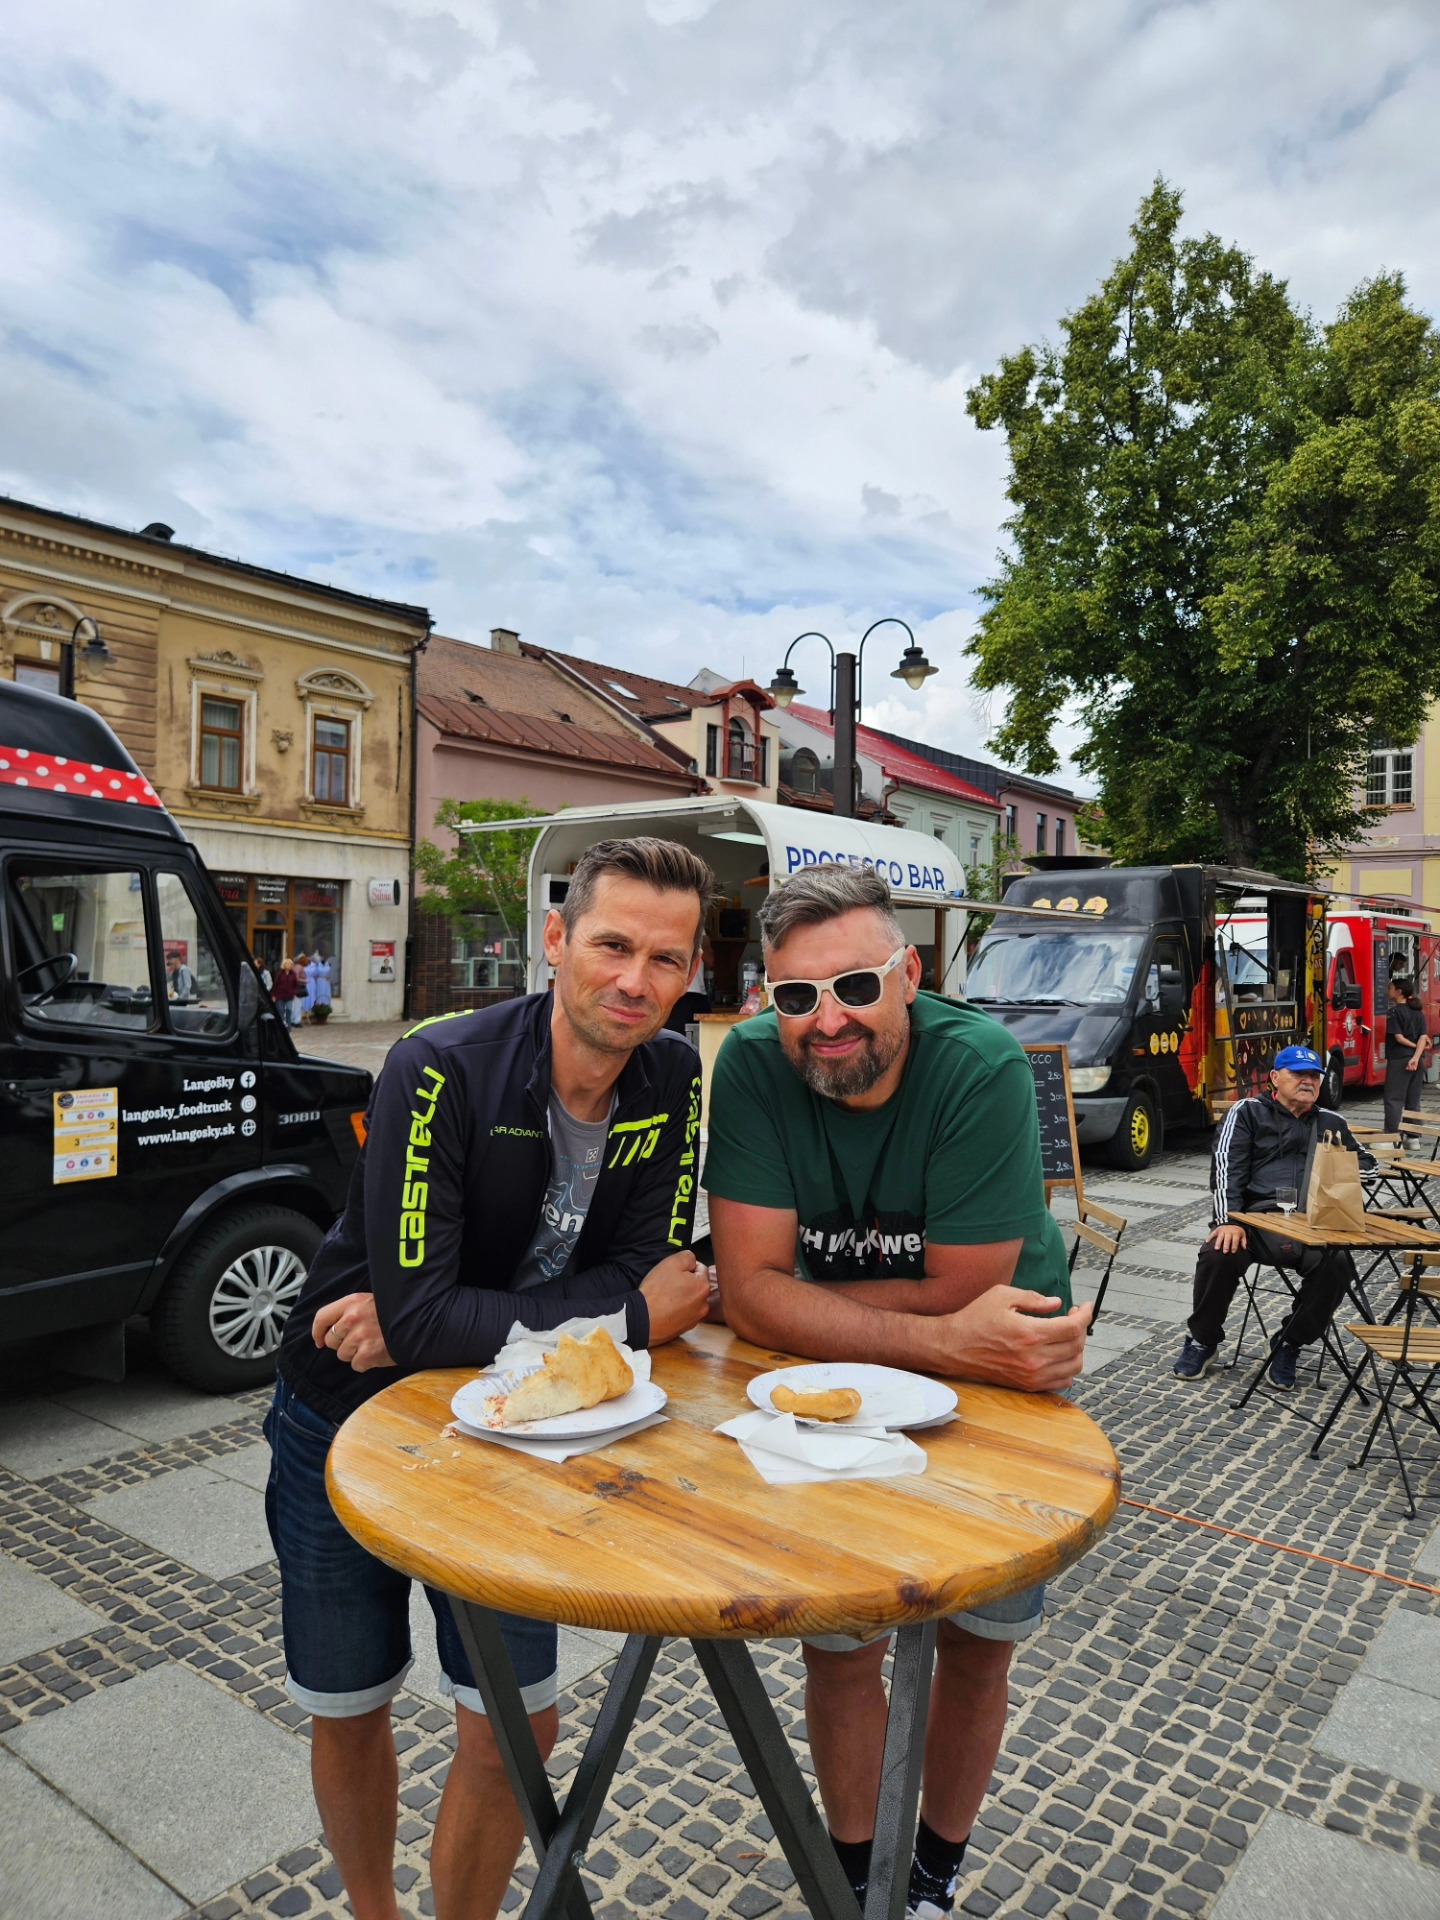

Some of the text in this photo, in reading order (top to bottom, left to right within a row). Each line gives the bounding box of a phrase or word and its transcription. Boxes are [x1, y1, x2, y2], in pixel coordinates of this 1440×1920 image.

[907, 863, 946, 892] BAR
[183, 1076, 235, 1092] Langošky
[122, 1100, 232, 1123] langosky_foodtruck
[137, 1123, 235, 1146] www.langosky.sk
